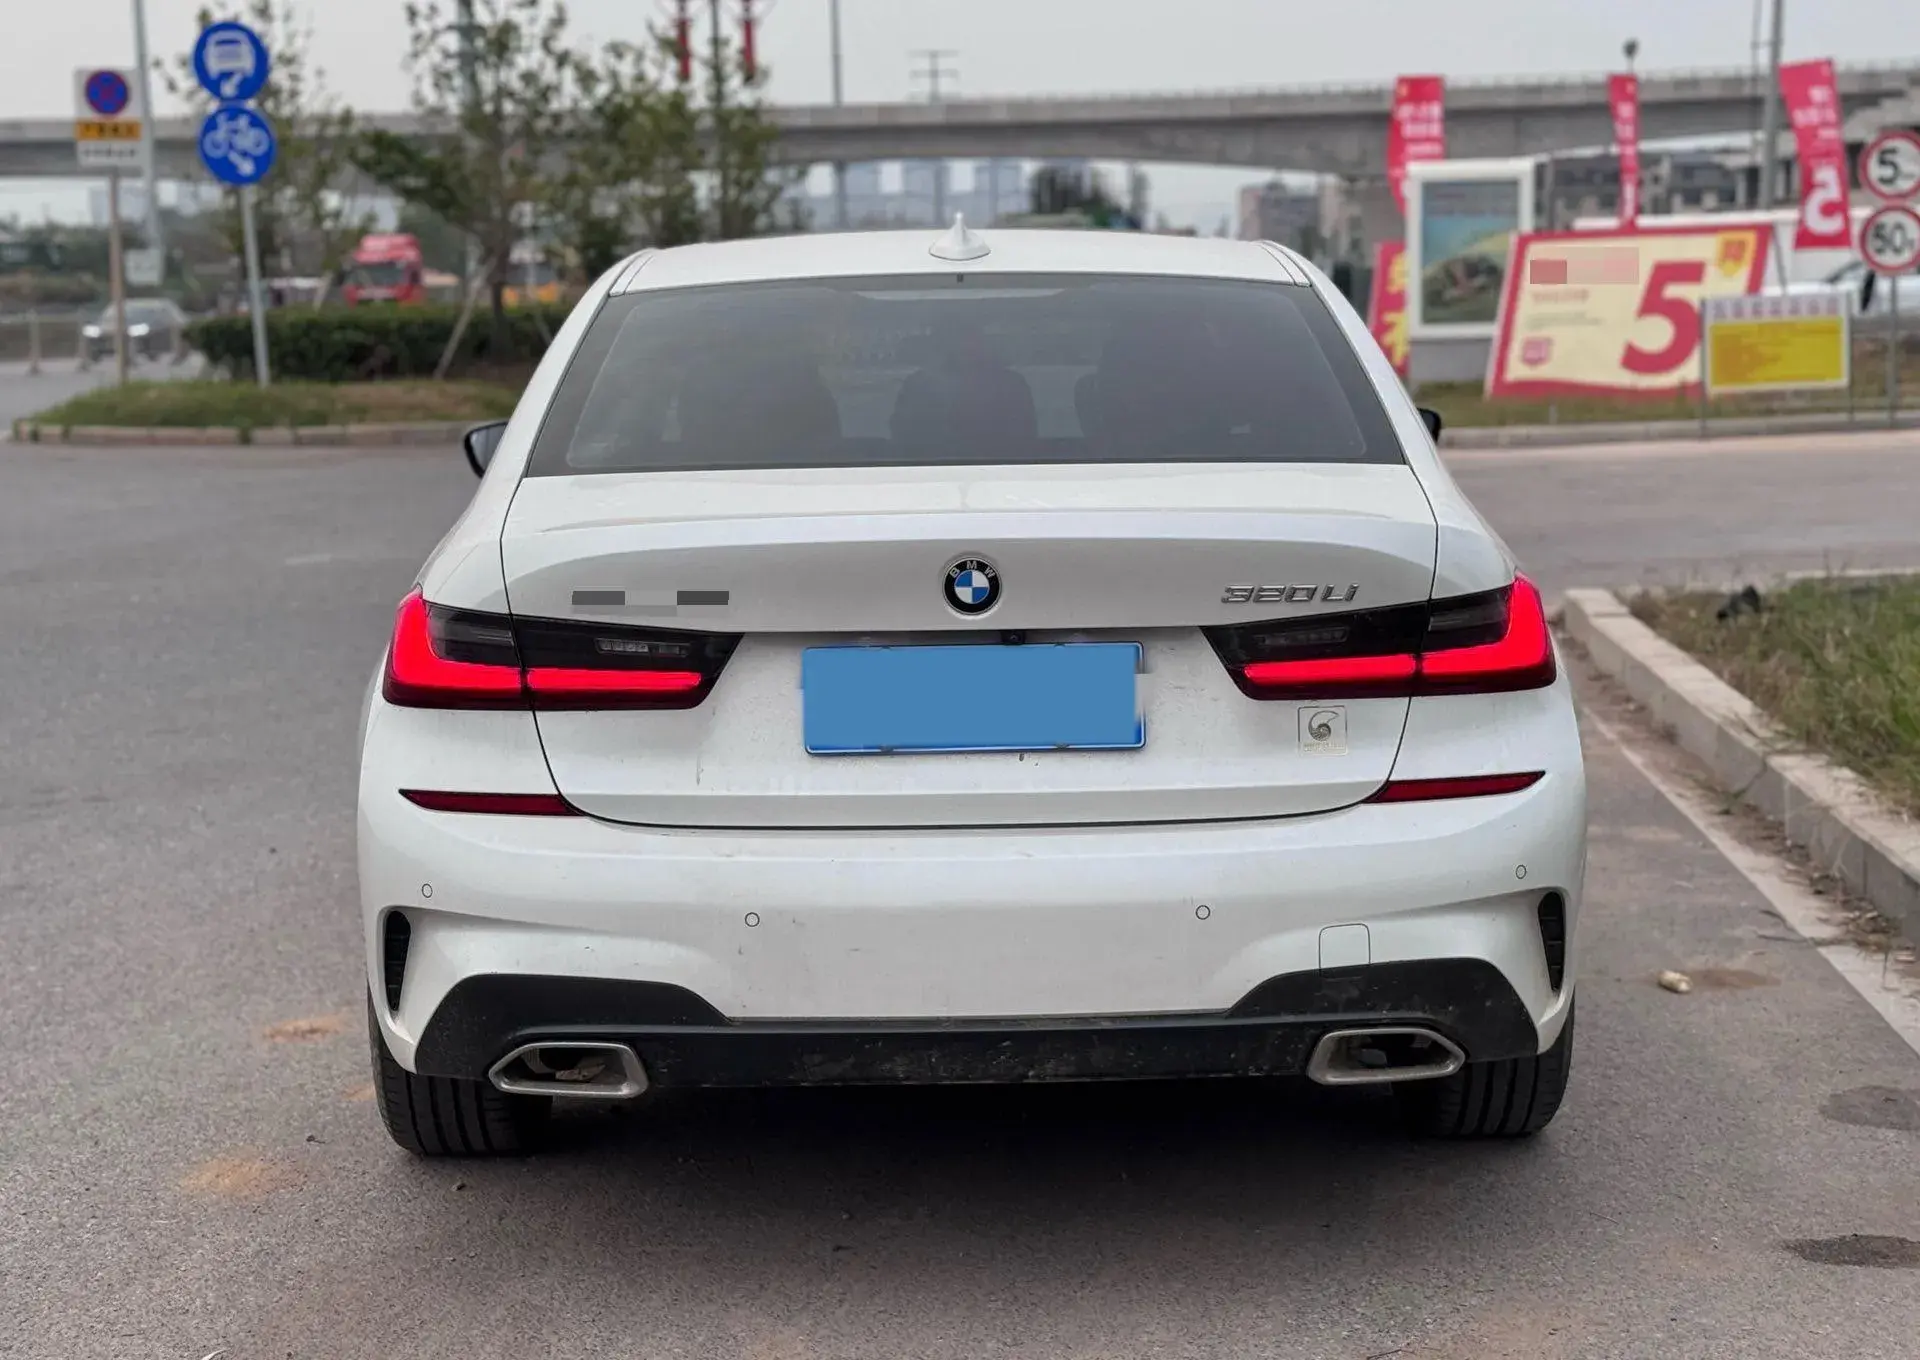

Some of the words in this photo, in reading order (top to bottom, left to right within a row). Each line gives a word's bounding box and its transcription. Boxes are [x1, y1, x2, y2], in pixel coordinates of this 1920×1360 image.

[1878, 147, 1899, 184] 5
[1872, 222, 1906, 256] 50
[1620, 261, 1706, 374] 5
[949, 560, 996, 579] BMW
[1221, 583, 1359, 603] 320Li
